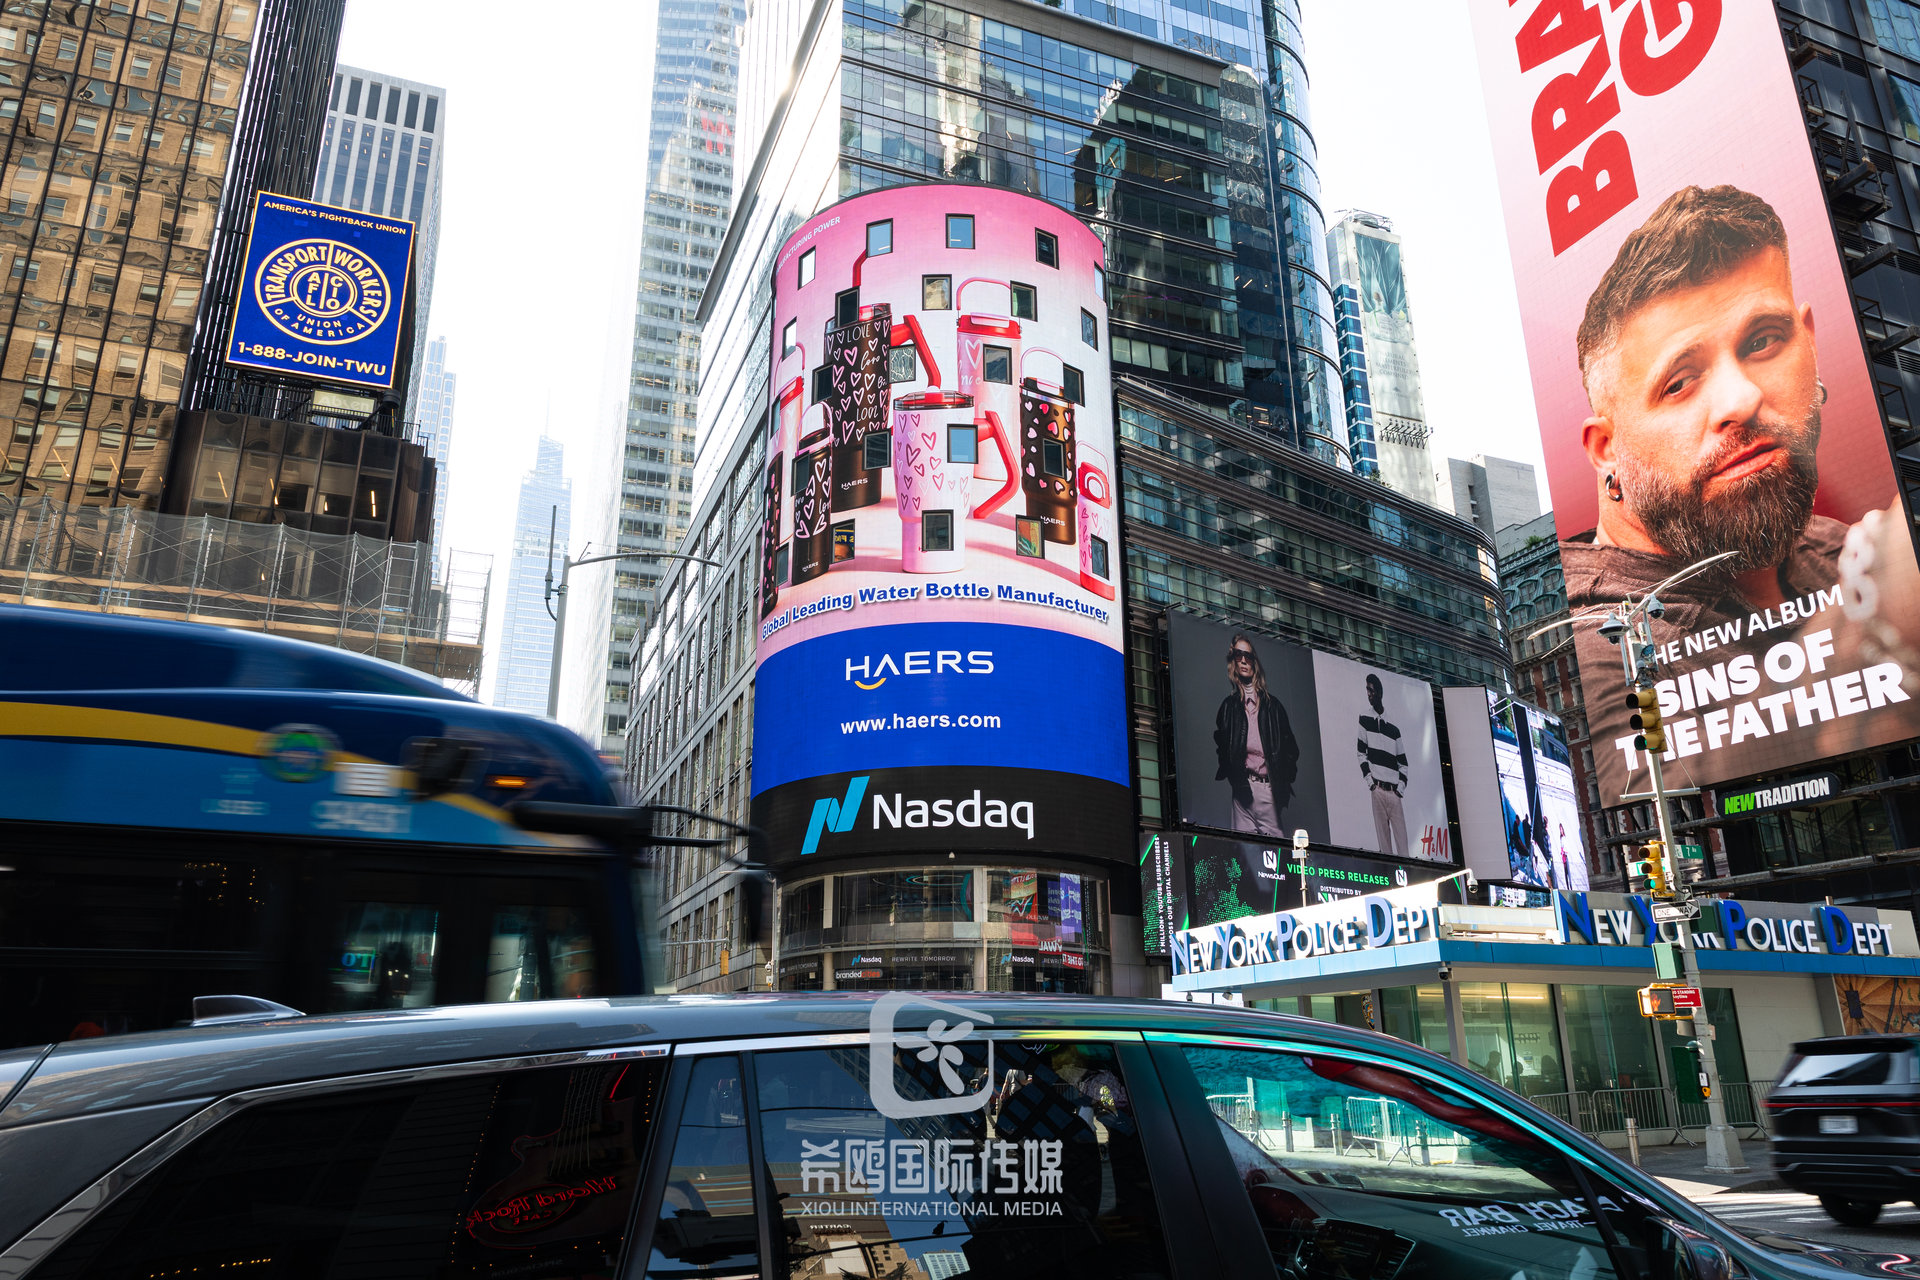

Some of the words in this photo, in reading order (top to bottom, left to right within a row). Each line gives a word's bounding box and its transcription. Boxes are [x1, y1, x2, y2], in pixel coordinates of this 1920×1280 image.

[1609, 0, 1722, 96] G
[1508, 0, 1638, 257] BRA
[264, 201, 317, 217] AMERICA'S
[319, 212, 374, 229] FIGHTBACK
[376, 223, 407, 235] UNION
[813, 216, 841, 236] POWER
[265, 246, 328, 301] TRANSPORT
[333, 249, 382, 318] WORKERS
[274, 308, 290, 321] OF
[291, 322, 366, 338] AMERICA
[297, 313, 342, 327] UNION
[847, 323, 871, 343] LOVE
[238, 341, 387, 376] 1-888-JOIN-TWU
[841, 477, 868, 488] HAERS
[1040, 516, 1066, 527] HAERS
[762, 611, 790, 640] Global
[792, 593, 853, 620] Leading
[858, 584, 919, 604] Water
[925, 582, 990, 599] Bottle
[996, 584, 1109, 622] Manufacturer
[1654, 640, 1682, 665] HE
[1685, 619, 1742, 657] NEW
[1747, 584, 1844, 637] ALBUM
[845, 651, 995, 681] HAERS
[1654, 654, 1761, 718] SINS
[1764, 628, 1835, 683] OF
[1703, 662, 1912, 750] FATHER
[841, 713, 1001, 735] www.haers.com
[873, 789, 1035, 840] Nasdaq
[1421, 825, 1448, 859] H&M
[1685, 846, 1691, 857] 7
[1163, 841, 1171, 876] CHANNELS
[1286, 863, 1315, 876] VIDEO
[1318, 868, 1346, 881] PRESS
[1348, 871, 1390, 886] RELEASES
[1320, 885, 1353, 896] DISTRIBUTED
[1559, 891, 1633, 945] NEW
[1630, 894, 1720, 948] YO
[1718, 899, 1821, 953] POLICE
[1820, 905, 1894, 956] DEPT
[1657, 909, 1671, 917] ONE
[1677, 905, 1693, 915] WAY
[1171, 931, 1216, 975] NEW
[1215, 923, 1277, 969] YORK
[1276, 913, 1359, 960] POLICE
[1364, 896, 1438, 948] DEPT
[835, 969, 881, 979] brandedcities
[861, 956, 882, 964] Nasdaq
[1012, 956, 1034, 964] Nasdaq
